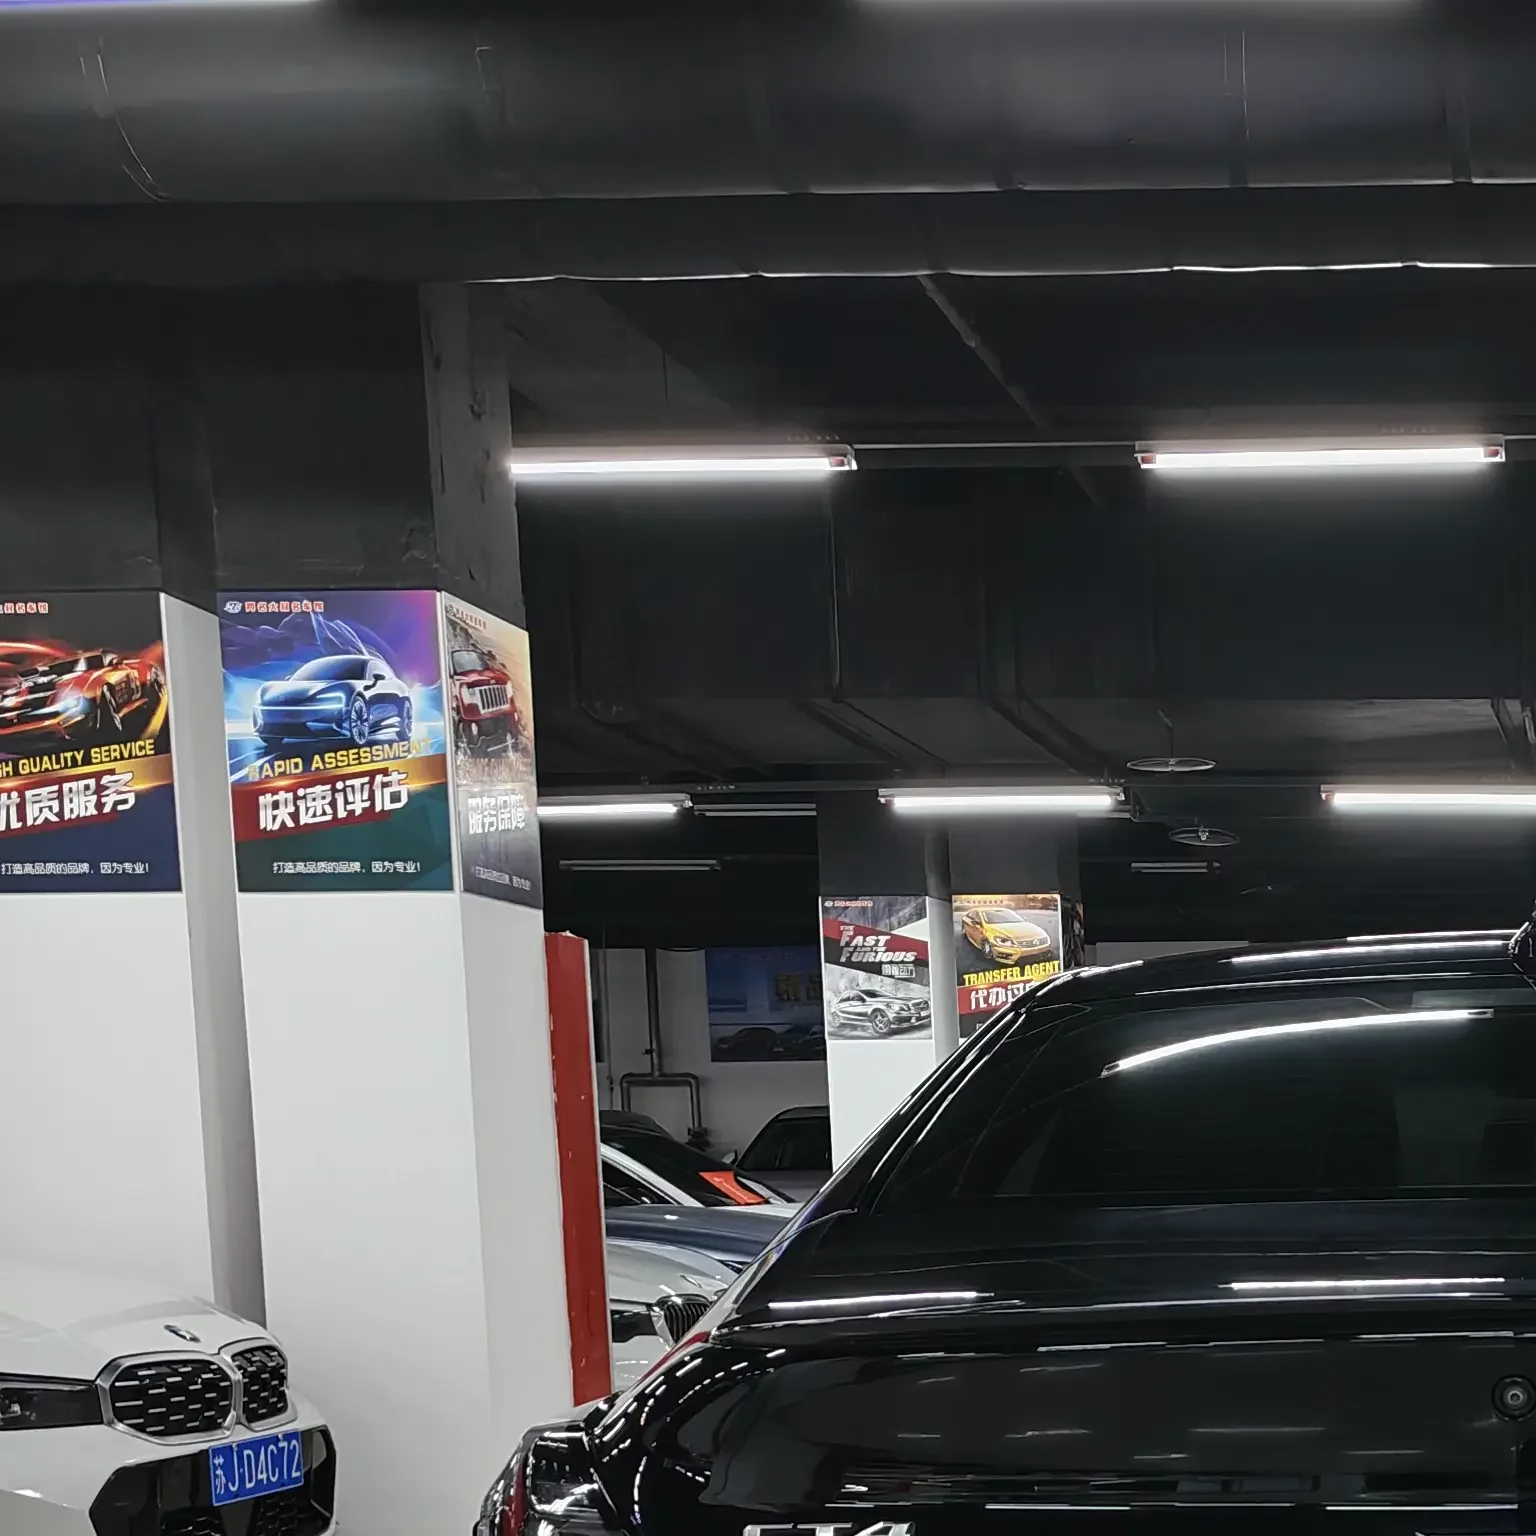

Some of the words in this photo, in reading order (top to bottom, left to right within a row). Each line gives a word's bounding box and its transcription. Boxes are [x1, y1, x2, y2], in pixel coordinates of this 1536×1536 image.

[18, 750, 85, 775] QUALITY
[90, 739, 155, 764] SERVICE
[249, 757, 303, 781] RAPID
[0, 772, 136, 832] 优质服务
[258, 771, 409, 832] 快速评估
[467, 793, 526, 835] 服务保障
[840, 930, 891, 947] FAST
[840, 946, 918, 963] FURIOUS
[963, 966, 1020, 986] TRANSFER
[1024, 960, 1060, 977] AGENT
